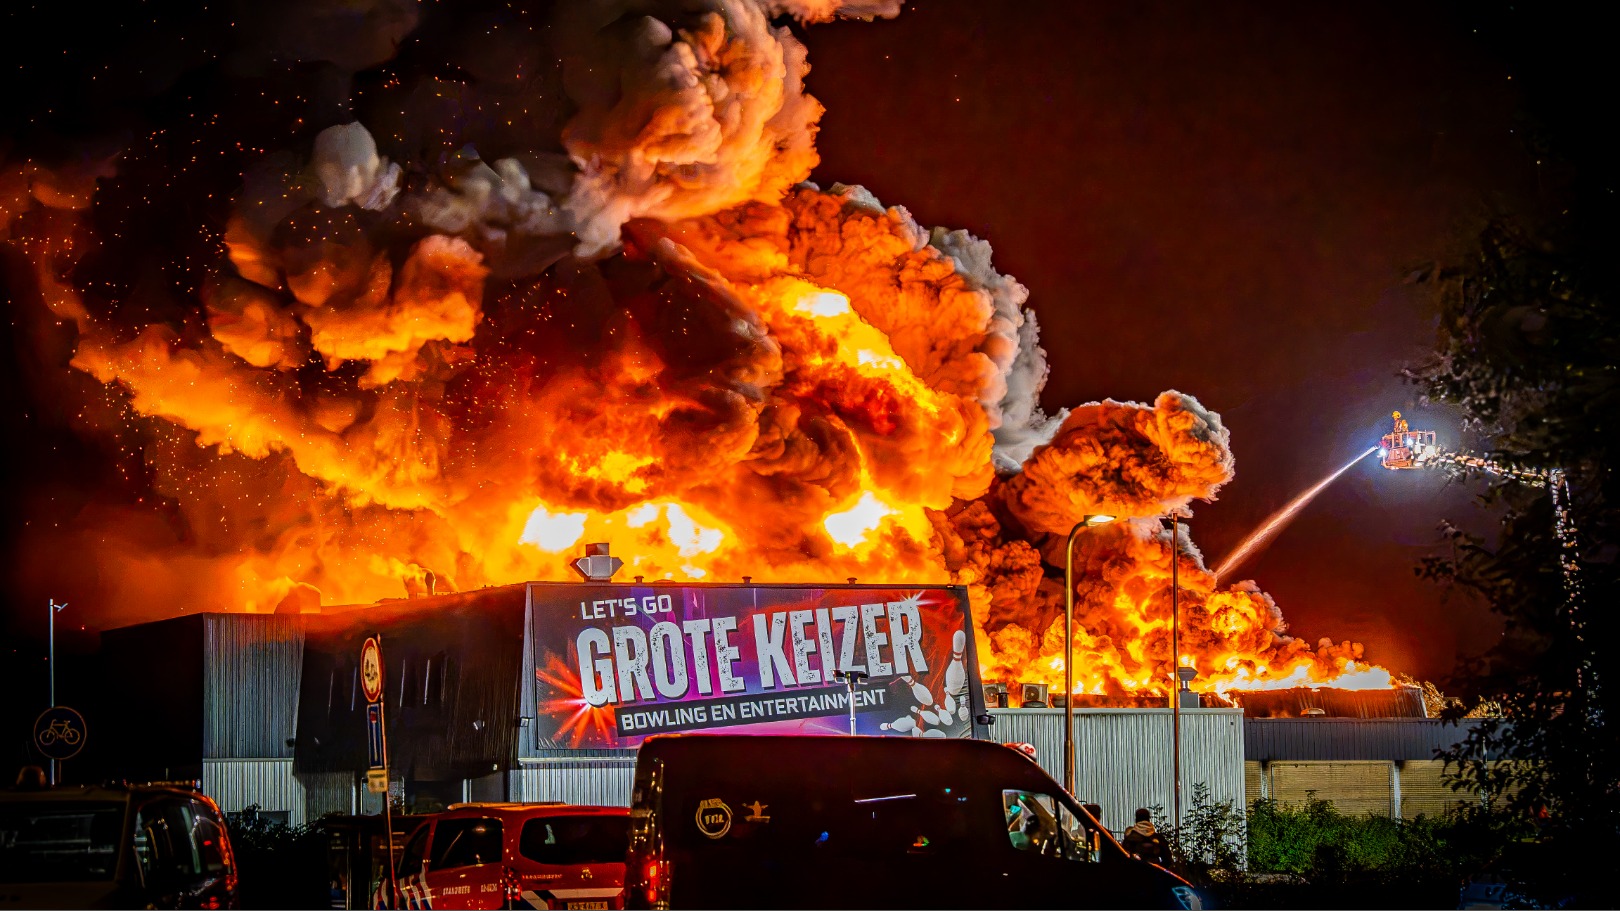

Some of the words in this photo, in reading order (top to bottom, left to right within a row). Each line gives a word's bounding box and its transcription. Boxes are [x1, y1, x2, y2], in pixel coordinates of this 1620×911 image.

[580, 597, 638, 620] LET'S
[642, 594, 673, 614] GO
[576, 615, 746, 707] GROTE
[752, 600, 929, 689] KEIZER
[621, 706, 708, 731] BOWLING
[711, 702, 736, 722] EN
[740, 688, 886, 719] ENTERTAINMENT
